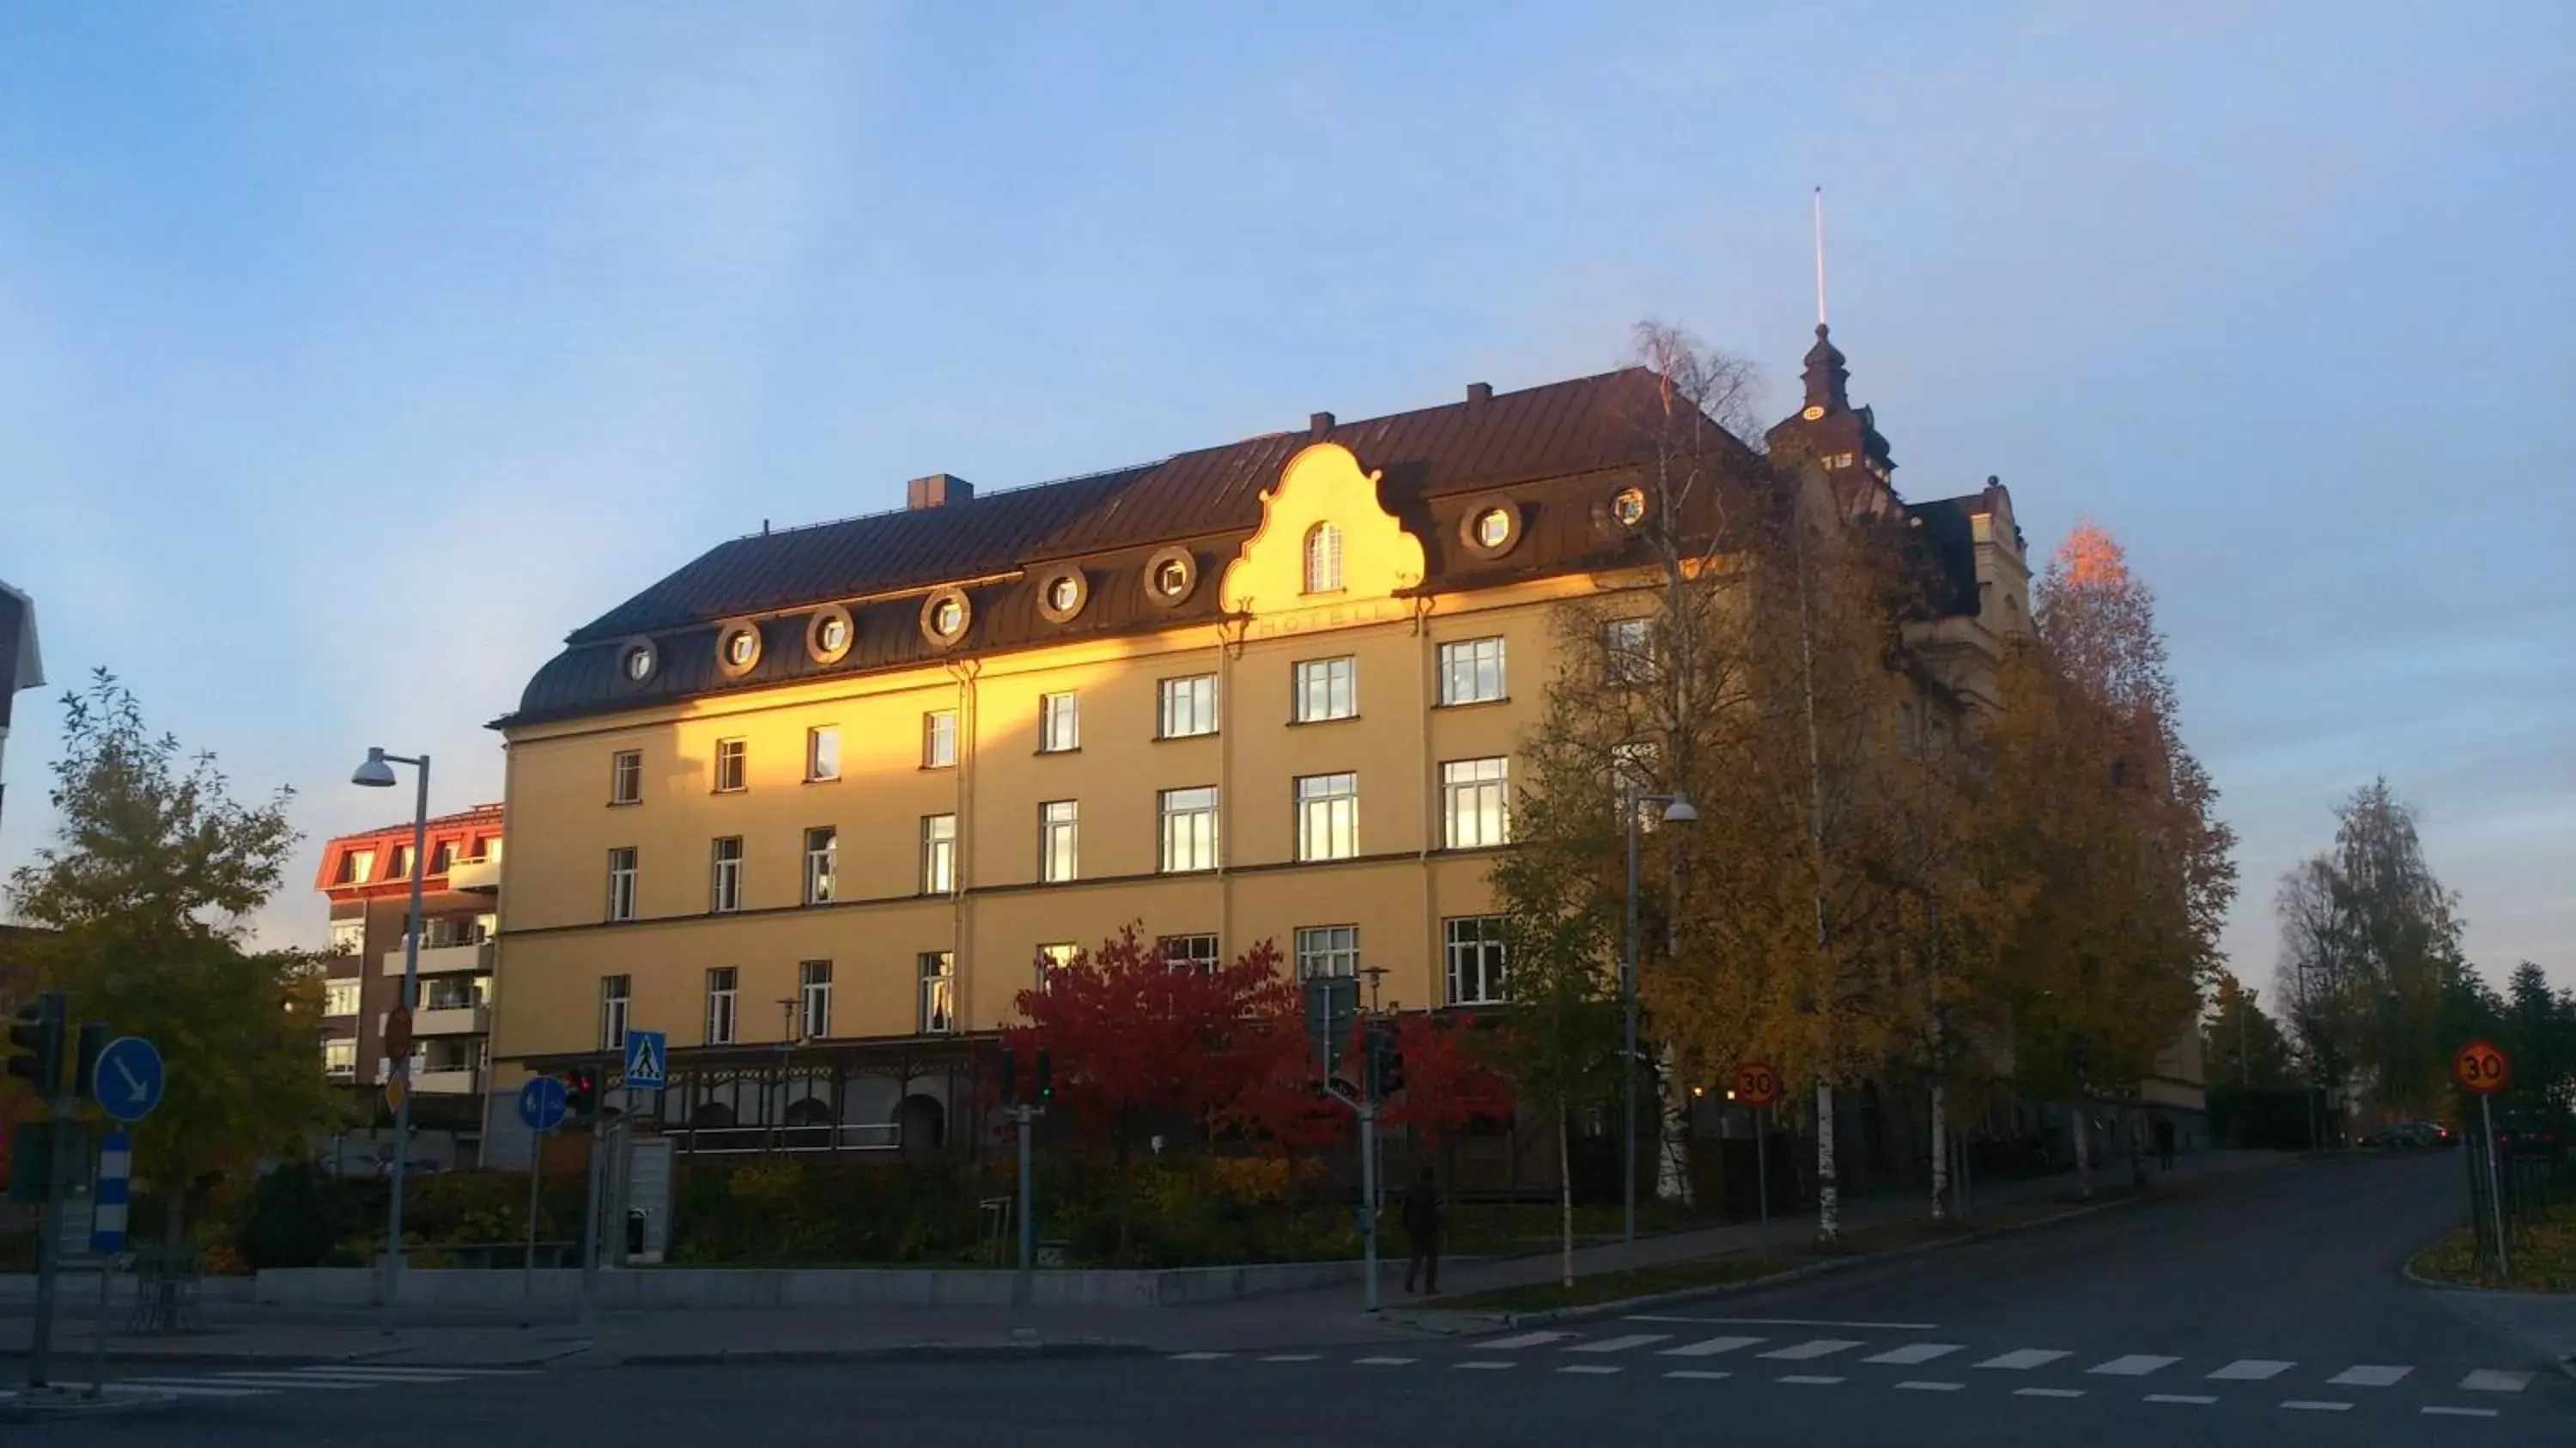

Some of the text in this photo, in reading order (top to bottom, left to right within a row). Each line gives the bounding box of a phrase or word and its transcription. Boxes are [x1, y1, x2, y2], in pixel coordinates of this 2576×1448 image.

[1259, 605, 1388, 636] HOTELL
[2464, 1055, 2501, 1081] 30
[1742, 1073, 1771, 1094] 30
